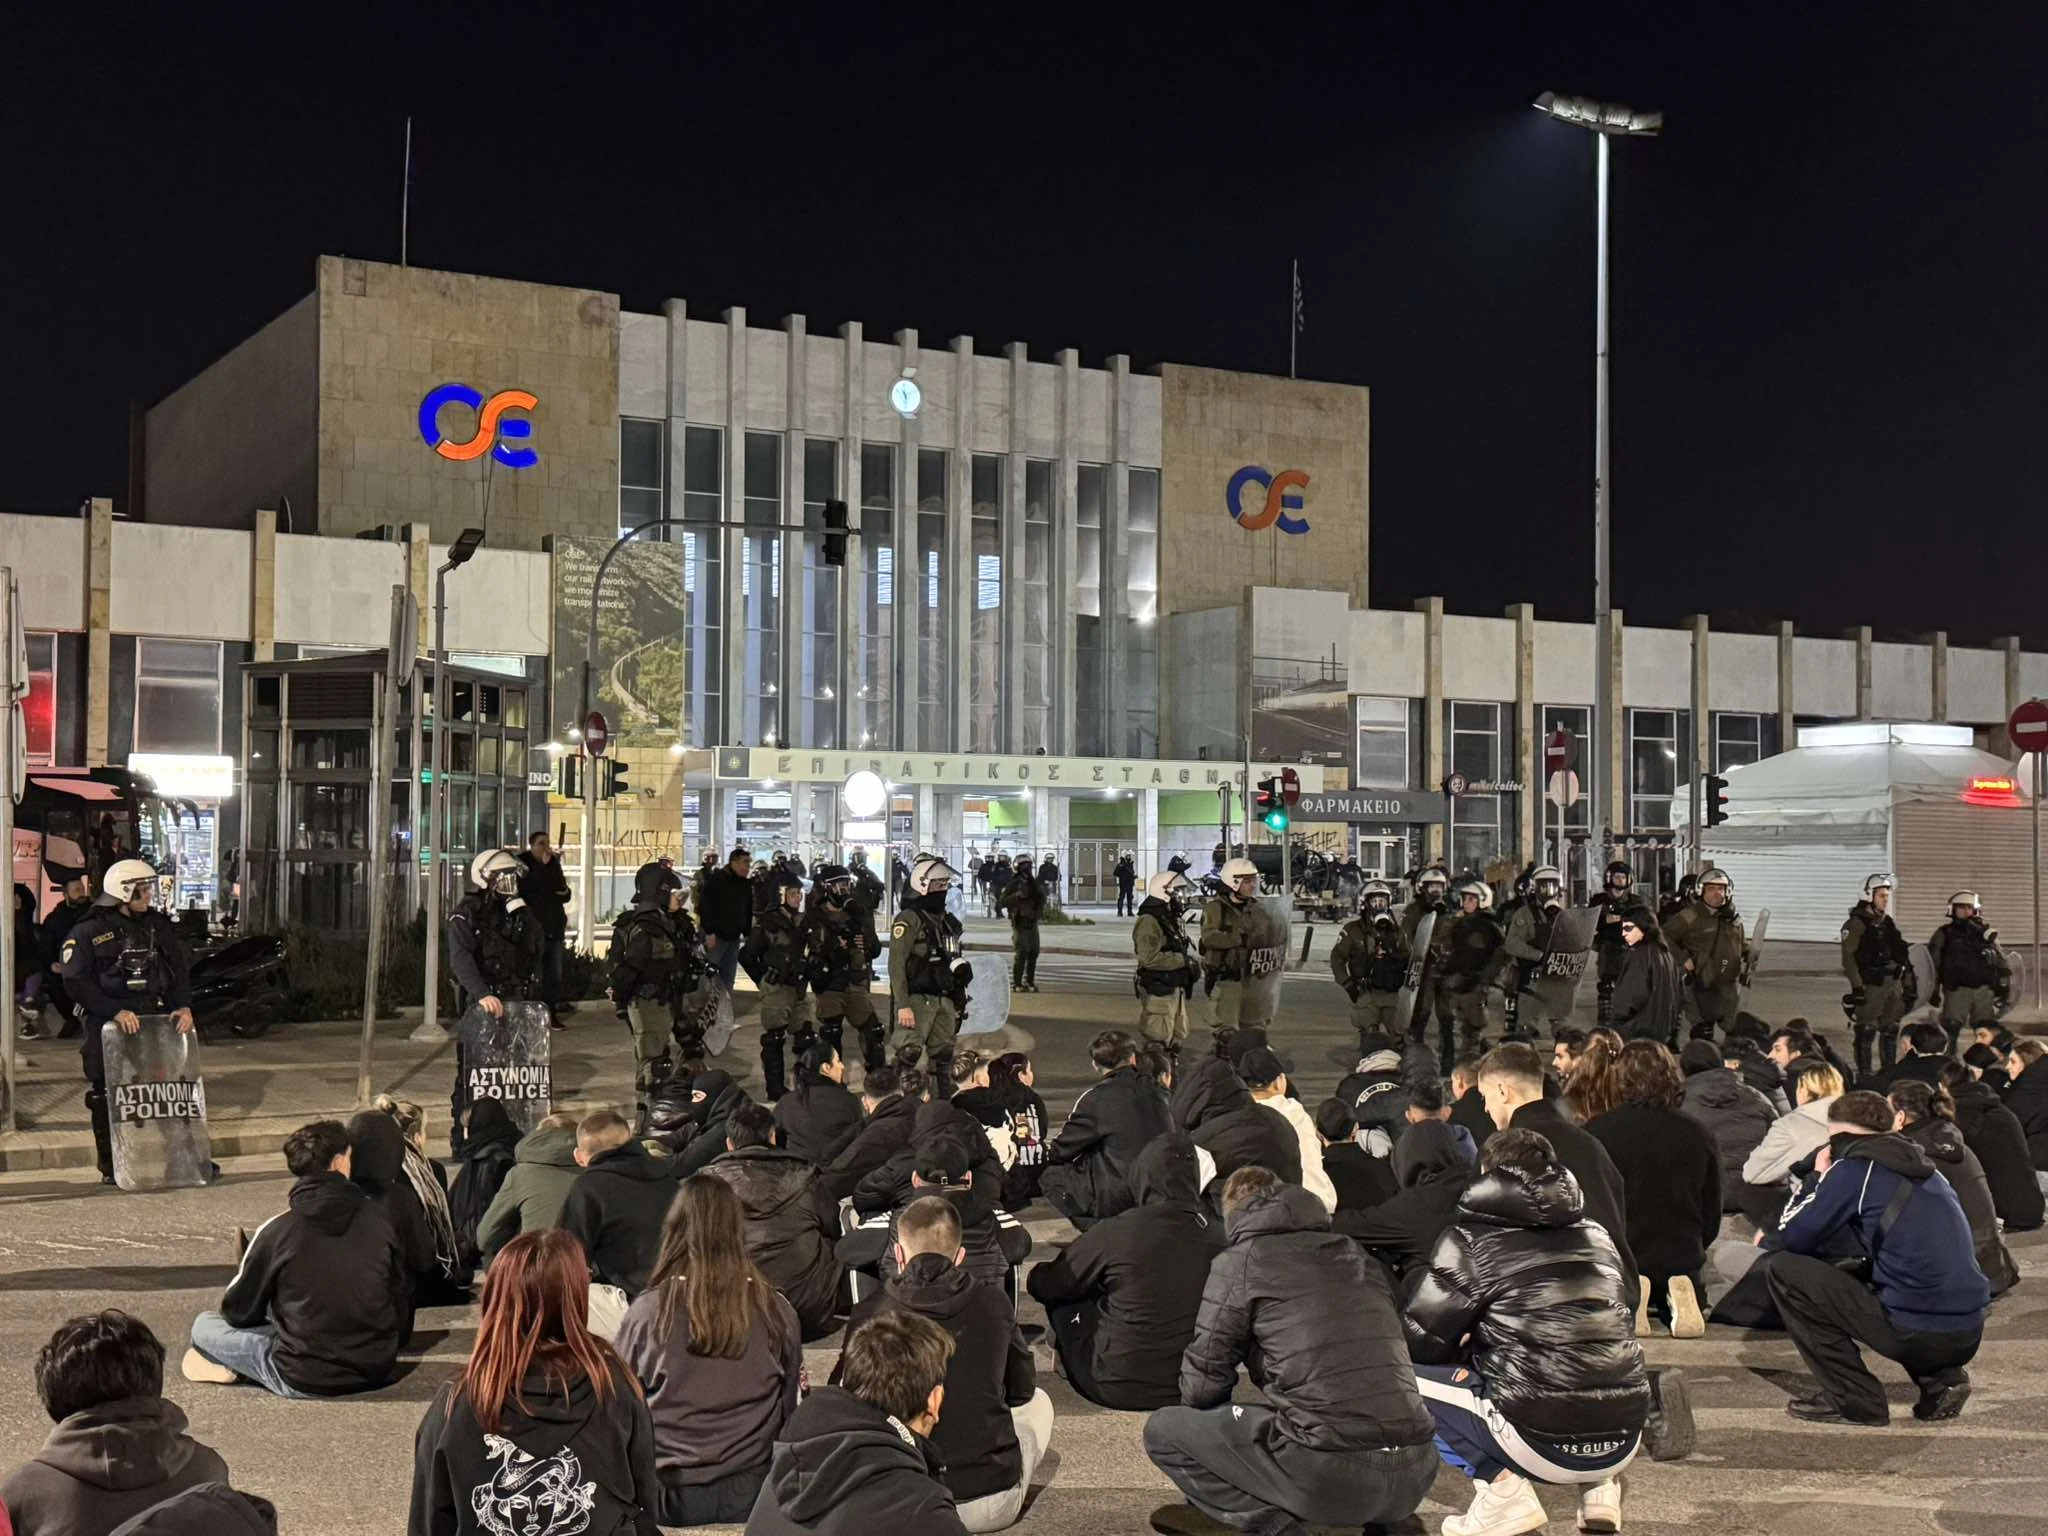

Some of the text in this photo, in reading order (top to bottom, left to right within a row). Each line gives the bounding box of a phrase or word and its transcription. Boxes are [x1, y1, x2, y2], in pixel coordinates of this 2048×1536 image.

[579, 563, 618, 573] transrm
[564, 574, 577, 582] our
[1301, 798, 1401, 815] ΦΑΡΜΑΚΕΙΟ
[469, 1066, 550, 1087] ΑΣΤΥΝΟΜΙΑ
[115, 1082, 202, 1106] ΑΣΤΥΝΟΜΙΑ
[473, 1084, 549, 1100] POLICE
[120, 1101, 201, 1120] POLICE
